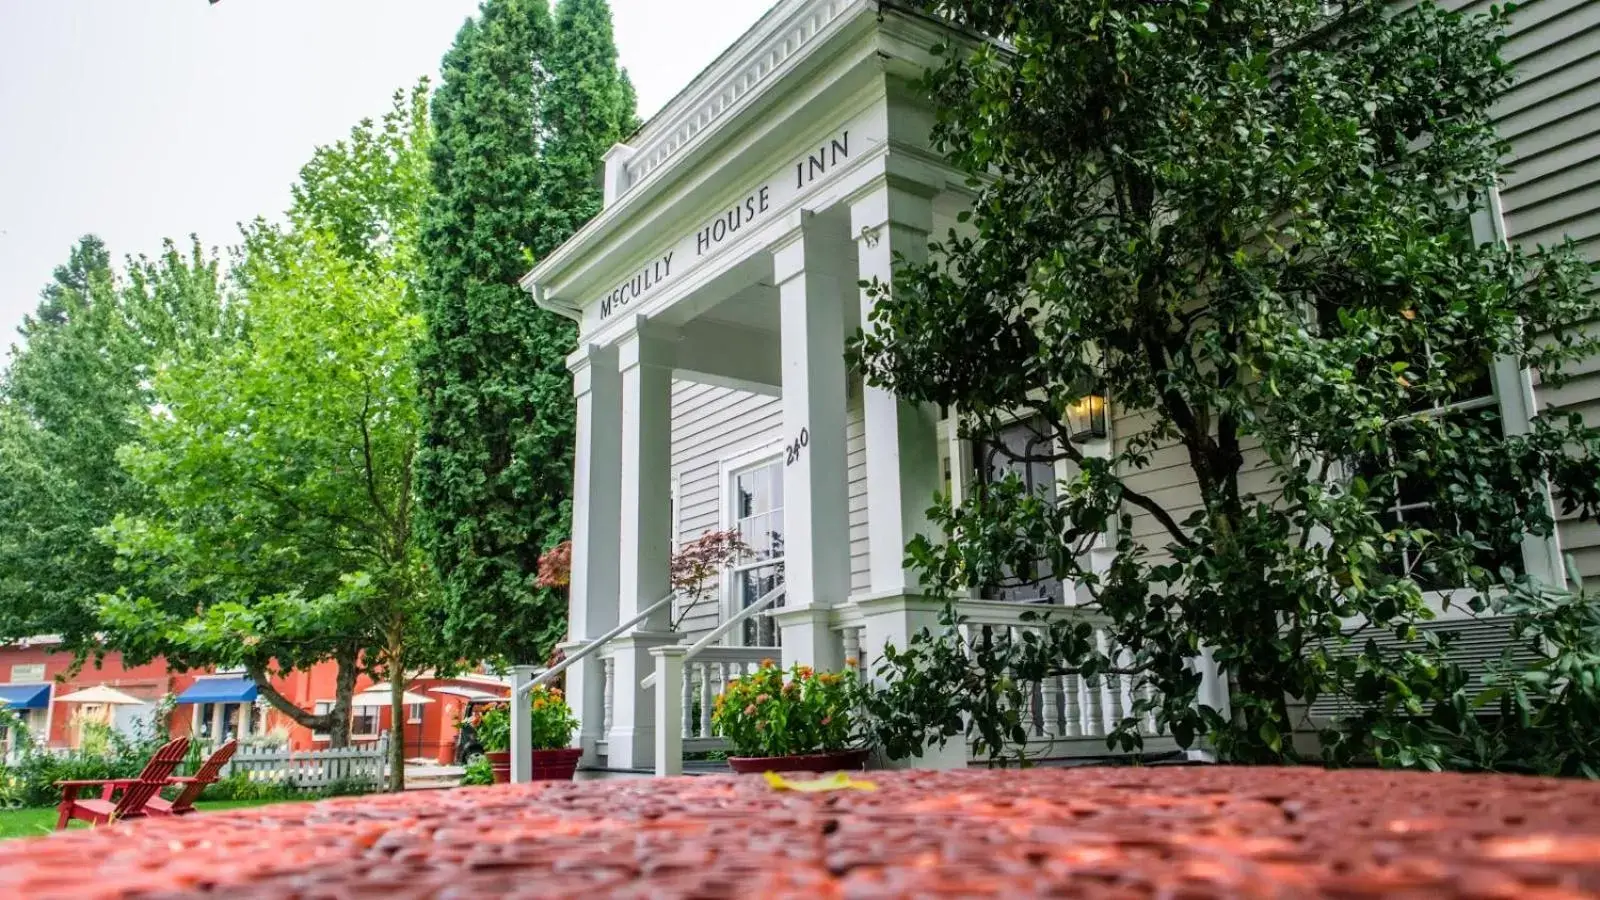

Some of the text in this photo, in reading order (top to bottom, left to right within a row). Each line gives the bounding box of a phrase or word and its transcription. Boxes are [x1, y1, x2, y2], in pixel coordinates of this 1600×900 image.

[696, 186, 769, 255] HOUSE
[796, 131, 849, 189] INN
[786, 426, 808, 466] 240
